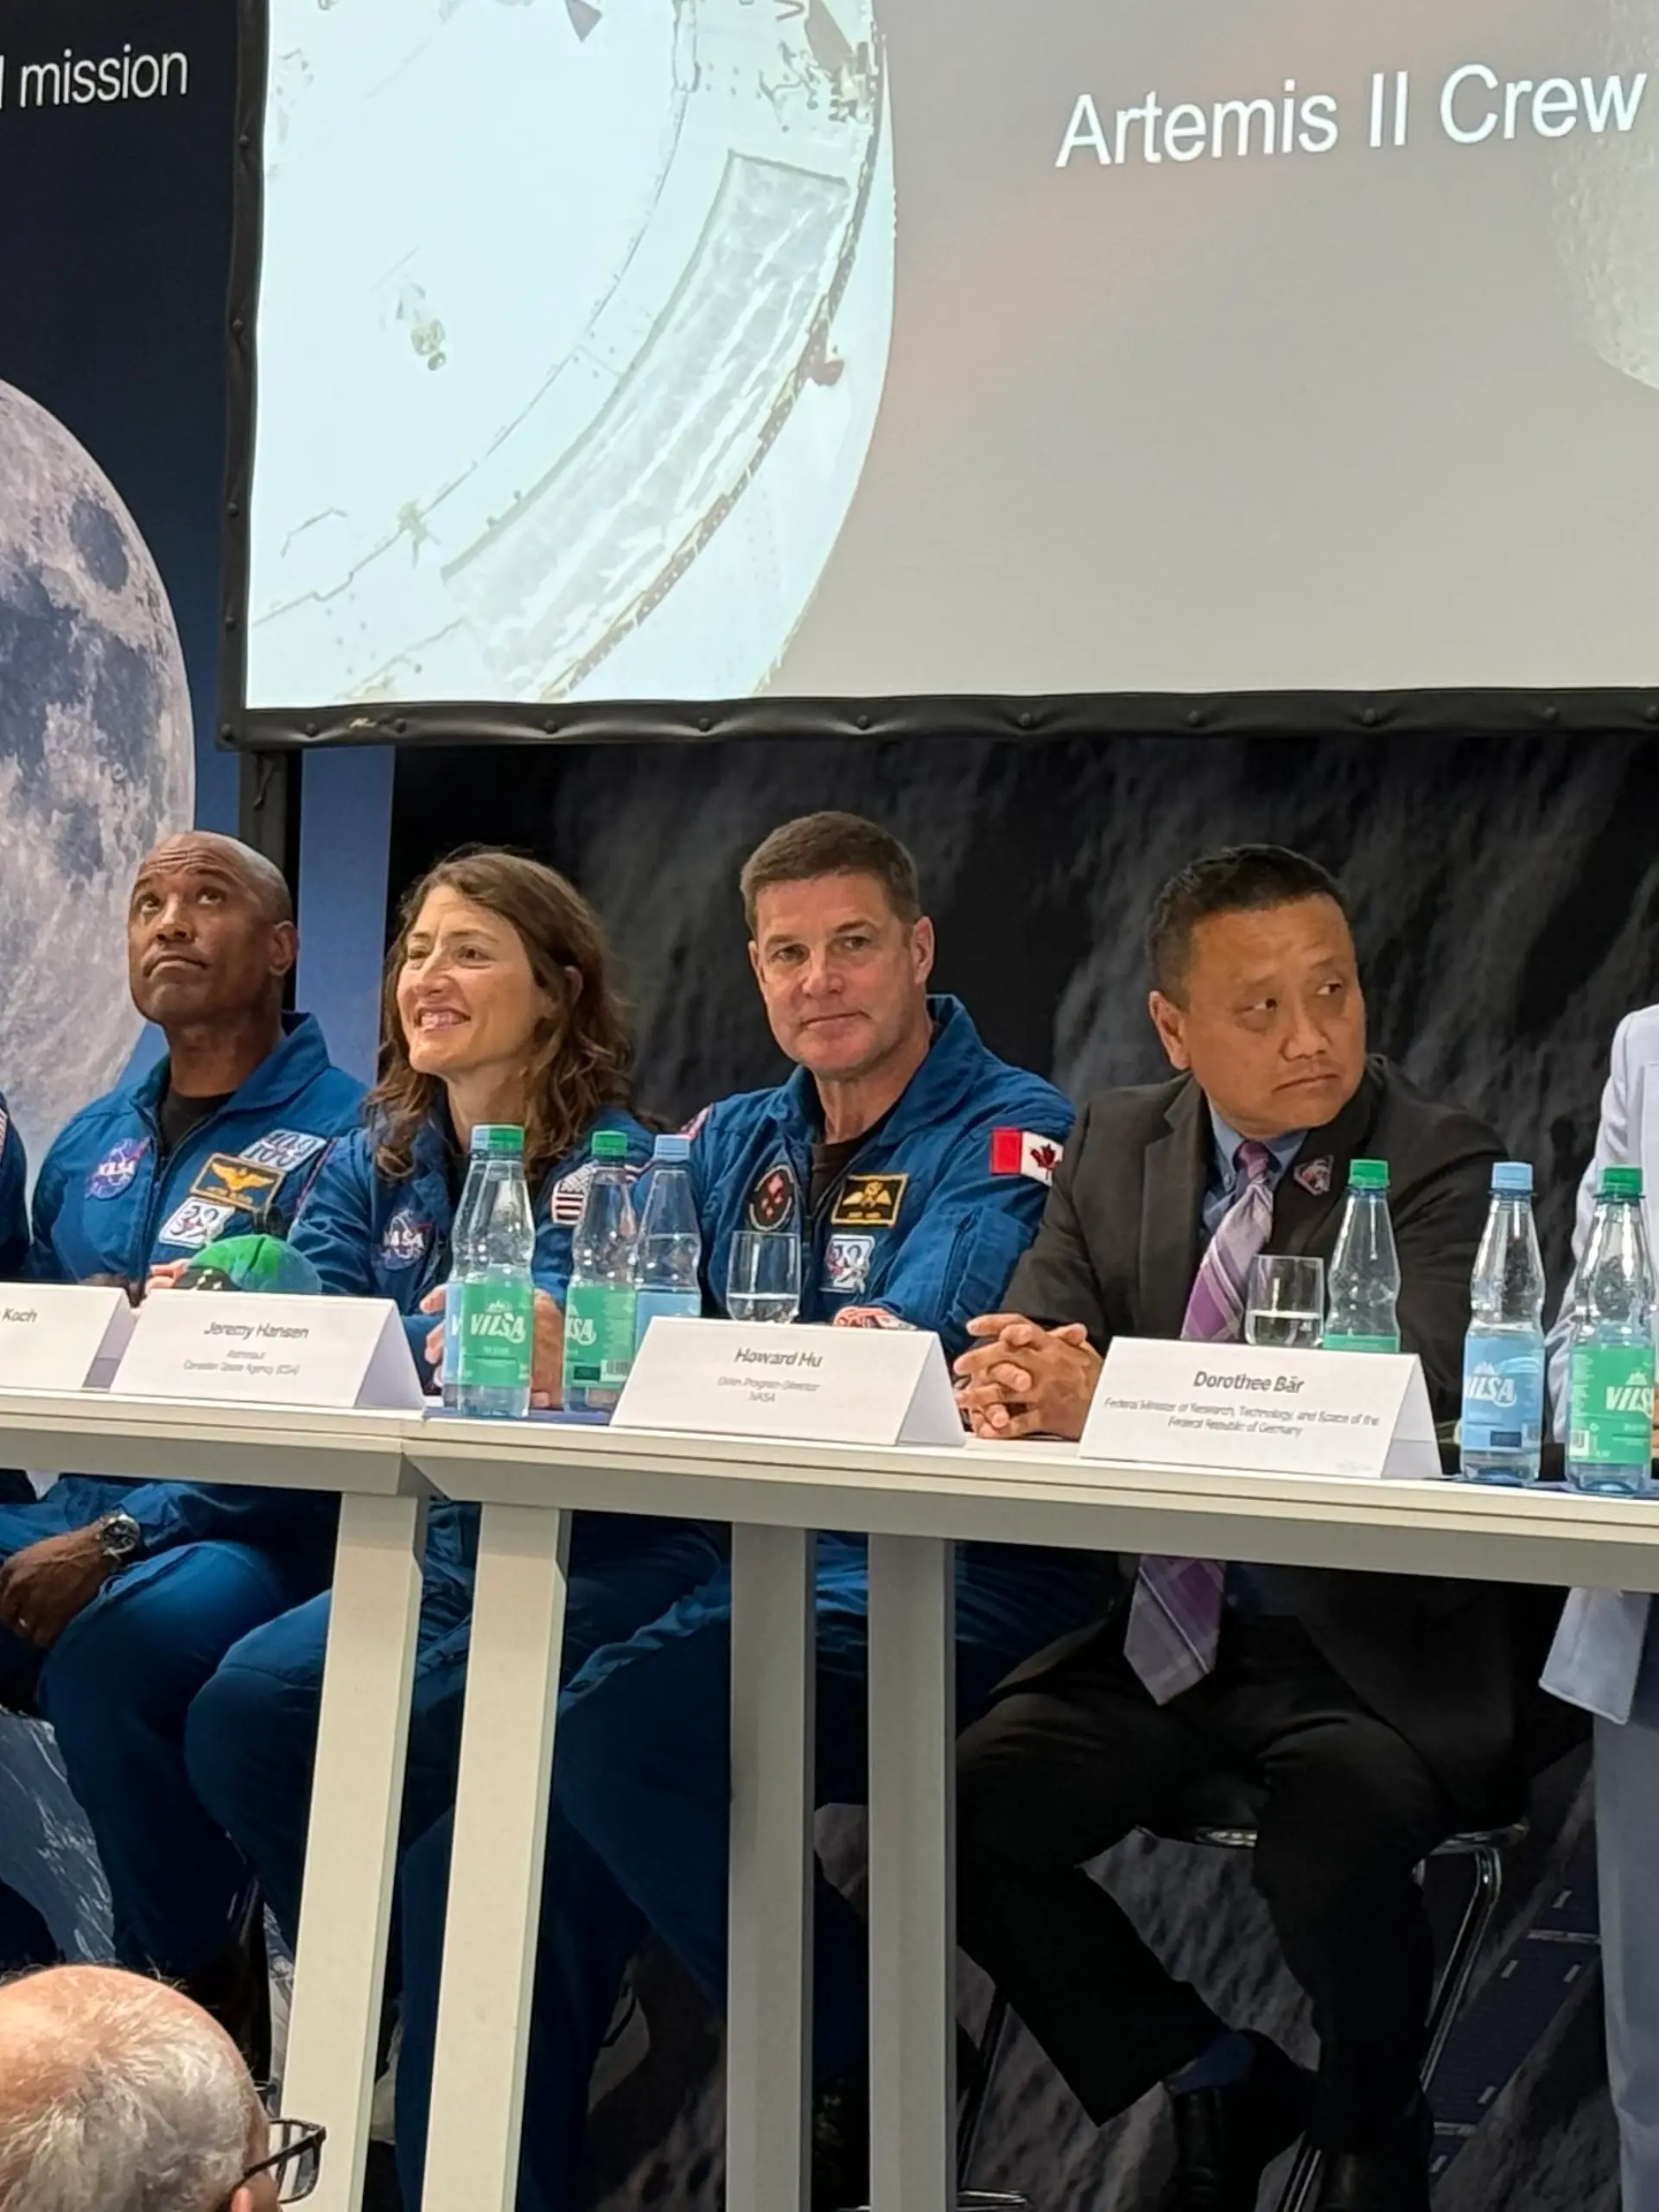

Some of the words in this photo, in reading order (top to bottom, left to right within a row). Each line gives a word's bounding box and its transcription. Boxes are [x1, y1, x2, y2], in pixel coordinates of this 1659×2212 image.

[20, 43, 188, 107] mission
[1054, 79, 1338, 168] Artemis
[1370, 71, 1408, 147] II
[1440, 64, 1647, 143] Crew
[2, 1307, 38, 1323] Koch
[204, 1322, 254, 1340] Jeremy
[257, 1323, 309, 1338] Hansen
[470, 1313, 526, 1344] VILSA
[734, 1347, 798, 1365] Howard
[798, 1351, 823, 1368] Hu
[1192, 1370, 1272, 1392] Dorothee
[1274, 1376, 1306, 1394] Bär
